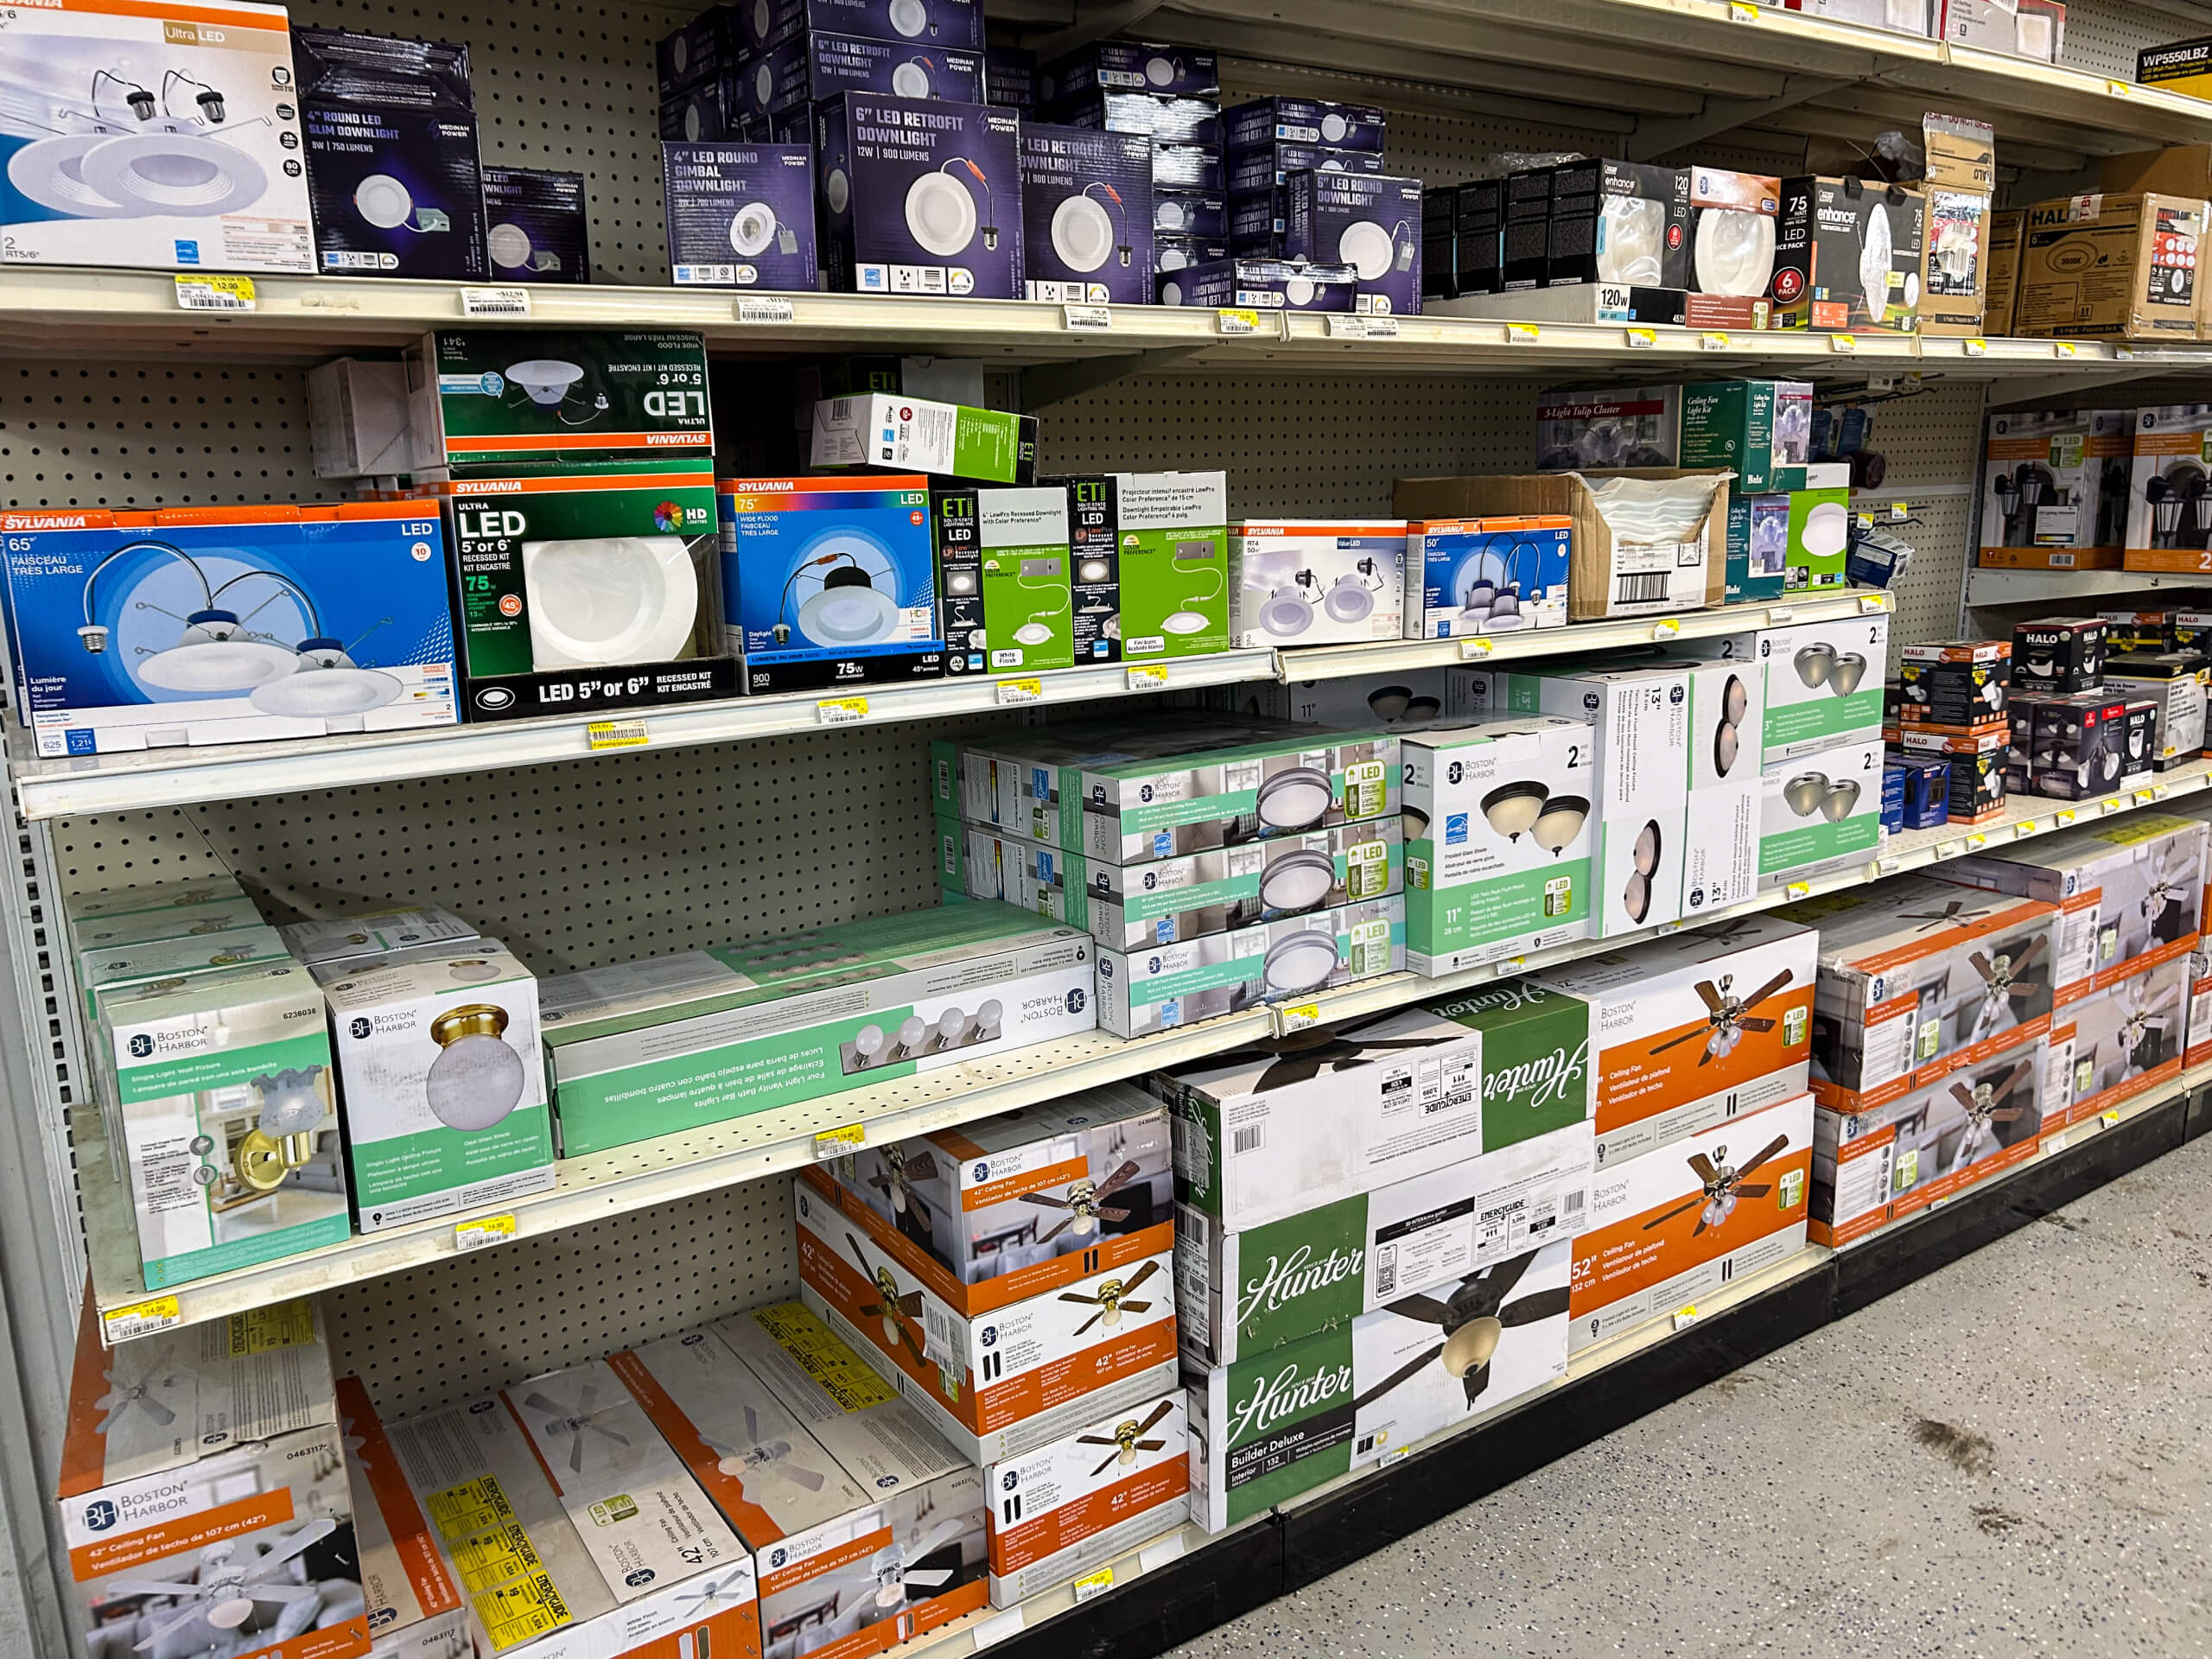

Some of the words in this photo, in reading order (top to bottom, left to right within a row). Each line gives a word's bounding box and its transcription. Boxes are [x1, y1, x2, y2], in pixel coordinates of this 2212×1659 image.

[165, 24, 195, 41] Ultra
[198, 29, 225, 42] LED
[819, 53, 872, 68] DOWNLIGHT
[946, 57, 974, 66] MEDINAH
[2143, 47, 2209, 67] WP5550LBZ
[876, 109, 900, 124] LED
[904, 111, 963, 130] RETROFIT
[988, 117, 1017, 126] MEDINAH
[308, 124, 334, 136] SLIM
[336, 125, 400, 140] DOWNLIGHT
[990, 124, 1015, 133] POWER
[856, 126, 937, 147] DOWNLIGHT
[1027, 138, 1049, 152] LED
[1051, 139, 1103, 156] RETROFIT
[857, 146, 874, 157] 12W
[883, 148, 897, 160] 900
[899, 149, 929, 162] LUMENS
[675, 165, 721, 177] GIMBAL
[676, 180, 747, 192] DOWNLIGHT
[1605, 176, 1635, 189] enhance
[1675, 175, 1688, 191] 120
[1317, 190, 1374, 207] DOWNLIGHT
[1789, 196, 1808, 211] 75
[1674, 207, 1686, 218] LED
[1817, 207, 1855, 225] enhance
[1784, 228, 1805, 241] LED
[1911, 238, 1921, 249] LED
[1783, 269, 1793, 286] 6
[1778, 284, 1796, 296] PACK
[644, 391, 705, 416] LED
[1545, 407, 1572, 418] 3-Light
[1573, 406, 1592, 419] Tulip
[1593, 404, 1621, 415] Cluster
[646, 434, 706, 444] SYLVANIA
[456, 481, 522, 493] SYLVANIA
[738, 481, 794, 492] SYLVANIA
[900, 493, 925, 505] LED
[686, 508, 707, 519] HD
[1082, 512, 1103, 524] LED
[4, 516, 86, 530] SYLVANIA
[402, 523, 433, 536] LED
[460, 511, 526, 537] LED
[1428, 525, 1464, 534] SYLVANIA
[949, 529, 971, 541] LED
[1248, 528, 1285, 537] SYLVANIA
[1555, 531, 1569, 540] LED
[10, 556, 67, 565] FAISCEAU
[499, 552, 510, 561] KIT
[476, 562, 511, 571] ENCASTRÉ
[1869, 626, 1877, 644] 2
[2026, 632, 2058, 644] HALO
[2083, 628, 2098, 642] HALO
[1722, 640, 1732, 658] 2
[1904, 648, 1924, 657] HALO
[922, 655, 939, 664] LED
[30, 676, 67, 684] Lumière
[657, 674, 696, 683] RECESSED
[698, 671, 712, 680] KIT
[753, 673, 770, 683] 900
[658, 683, 671, 693] KIT
[671, 681, 711, 692] ENCASTRÉ
[2130, 715, 2145, 727] HALO
[1906, 736, 1927, 745] HALO
[1567, 745, 1578, 768] 2
[1864, 753, 1871, 770] 2
[1361, 766, 1381, 779] LED
[1404, 763, 1414, 785] 2
[1465, 769, 1495, 781] HARBOR
[1155, 789, 1181, 798] HARBOR
[1363, 846, 1382, 860] LED
[1159, 876, 1183, 887] HARBOR
[1555, 879, 1568, 890] LED
[1366, 925, 1386, 938] LED
[1163, 961, 1189, 969] HARBOR
[1021, 995, 1063, 1011] HARBOR
[283, 1007, 316, 1020] 6236038
[1793, 1010, 1804, 1020] LED
[375, 1020, 416, 1034] HARBOR
[1601, 1014, 1634, 1032] HARBOR
[159, 1038, 207, 1052] HARBOR
[789, 1052, 799, 1061] de
[802, 1047, 823, 1058] Luces
[747, 1060, 765, 1071] para
[766, 1057, 787, 1067] barra
[132, 1071, 154, 1083] Single
[156, 1068, 175, 1079] Light
[176, 1065, 195, 1075] Wall
[195, 1061, 221, 1071] Fixture
[695, 1071, 715, 1082] baño
[717, 1065, 744, 1077] espejo
[806, 1071, 824, 1082] Four
[1484, 1038, 1589, 1108] Hunter
[1609, 1065, 1628, 1079] Ceiling
[1630, 1064, 1642, 1075] Fan
[677, 1077, 693, 1086] con
[785, 1076, 805, 1088] Light
[1609, 1077, 1638, 1092] Ventilateur
[1640, 1075, 1648, 1084] de
[1649, 1066, 1671, 1082] plafond
[649, 1080, 676, 1093] cuatro
[738, 1087, 756, 1097] Bath
[759, 1081, 783, 1093] Vanity
[1609, 1090, 1637, 1105] Ventilador
[1638, 1088, 1645, 1097] de
[1647, 1081, 1663, 1094] techo
[605, 1087, 646, 1103] bombillas
[722, 1092, 735, 1102] Bar
[694, 1096, 720, 1108] Lights
[991, 1162, 1022, 1177] HARBOR
[1789, 1173, 1801, 1183] LED
[1593, 1193, 1626, 1213] HARBOR
[1603, 1243, 1622, 1257] Ceiling
[1624, 1240, 1636, 1250] Fan
[1603, 1255, 1631, 1269] Ventilateur
[1634, 1252, 1641, 1262] de
[1643, 1239, 1664, 1255] plafond
[1602, 1267, 1630, 1282] Ventilador
[1632, 1264, 1639, 1273] de
[1641, 1255, 1657, 1268] techo
[1227, 1244, 1363, 1328] Hunter
[145, 1305, 166, 1314] 14.99
[1217, 1363, 1351, 1452] Hunter
[1232, 1447, 1268, 1468] Builder
[1270, 1432, 1305, 1452] Deluxe
[1232, 1467, 1256, 1482] Interior
[1268, 1457, 1280, 1466] 132
[124, 1497, 188, 1521] HARBOR
[92, 1552, 143, 1571] Ventilador
[145, 1548, 158, 1558] de
[160, 1538, 188, 1554] techo
[191, 1535, 204, 1545] de
[206, 1527, 221, 1540] 107
[224, 1523, 240, 1534] cm
[624, 1539, 645, 1567] HARBOR
[790, 1544, 823, 1561] HARBOR
